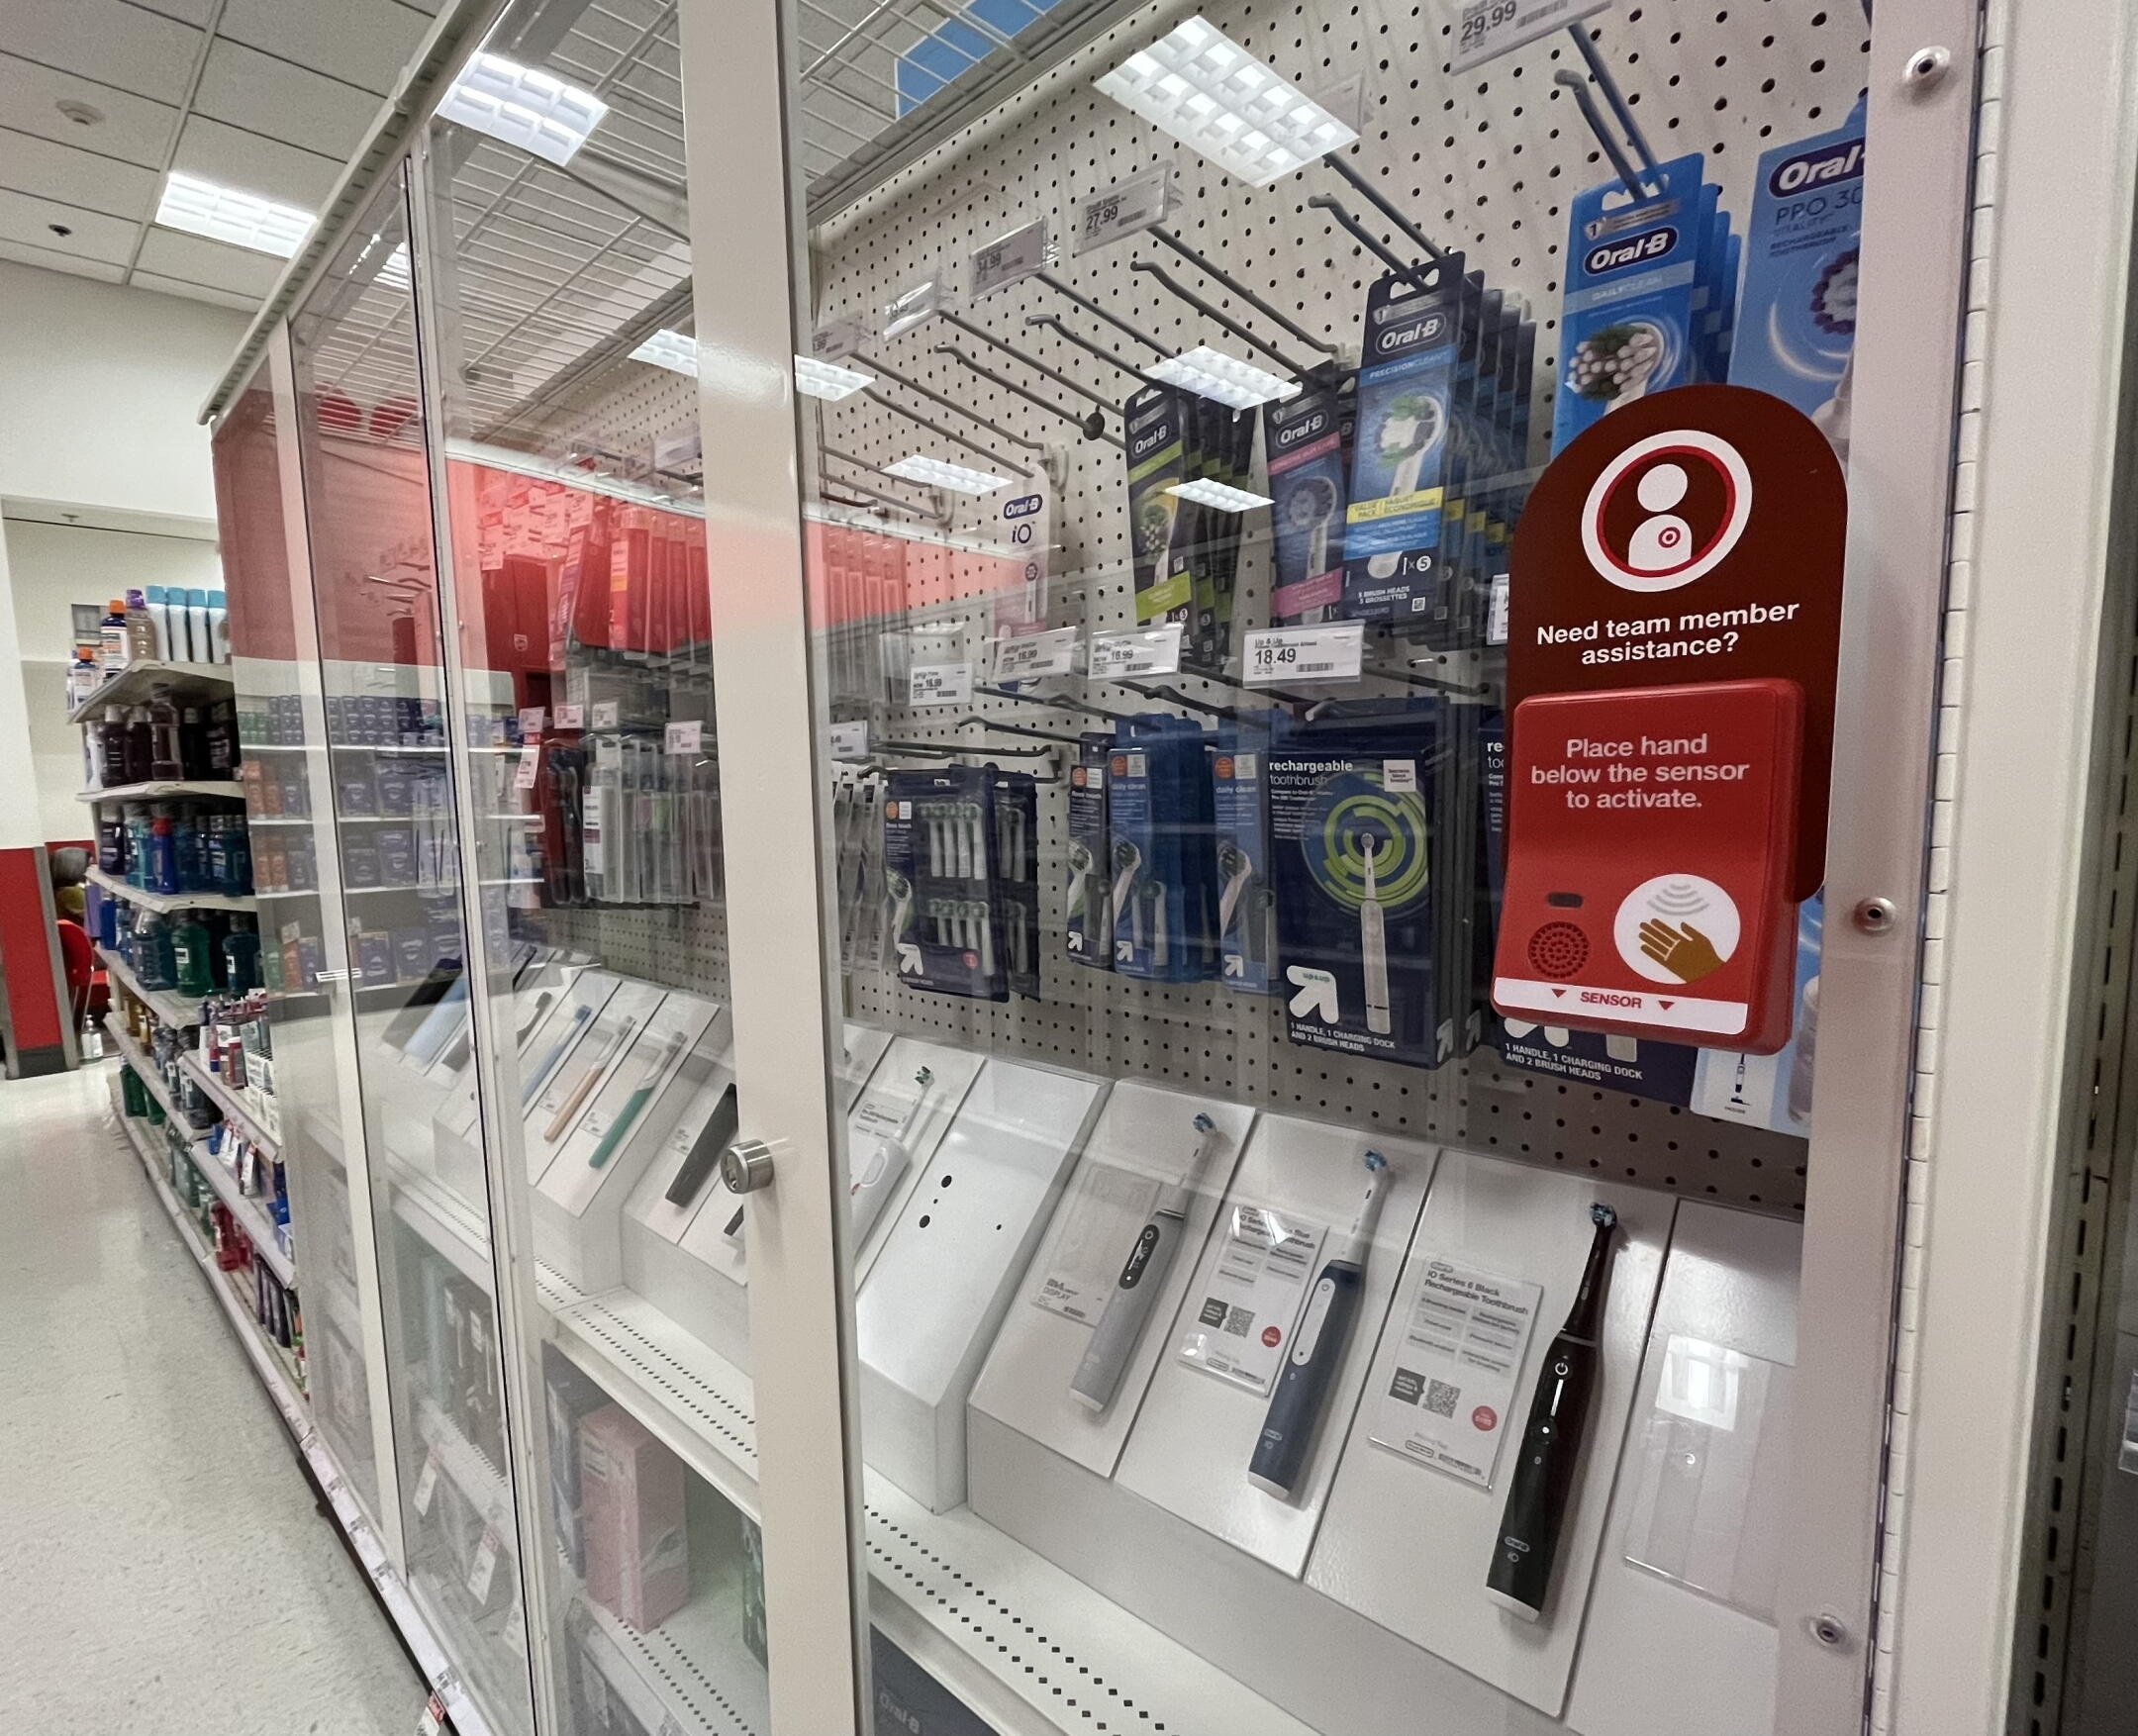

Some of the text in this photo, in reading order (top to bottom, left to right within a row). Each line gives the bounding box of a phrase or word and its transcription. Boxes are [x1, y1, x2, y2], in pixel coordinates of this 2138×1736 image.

[1461, 0, 1517, 43] 29.99
[1086, 205, 1118, 231] 27.99
[1591, 233, 1669, 270] Oral-B
[1382, 319, 1439, 348] Oral-B
[1134, 426, 1167, 453] Oral-B
[1280, 415, 1322, 443] Oral-B
[1005, 498, 1039, 516] Oral-B
[1537, 602, 1799, 645] Need team member
[1255, 648, 1297, 665] 18.49
[1582, 630, 1739, 665] assistance?
[1567, 732, 1708, 758] Place hand
[1269, 759, 1353, 774] rechargeable
[1530, 763, 1750, 784] below the sensor
[1270, 774, 1327, 786] toothbrush
[1566, 788, 1702, 809] to activate.
[1580, 992, 1642, 1009] SENSOR
[1373, 1037, 1396, 1049] DOCK
[1506, 1052, 1524, 1064] AND
[1535, 1059, 1567, 1073] BRUSH
[1569, 1067, 1602, 1081] HEADS
[1512, 1044, 1552, 1060] HANDLE,
[1561, 1055, 1611, 1073] CHARGING
[1614, 1066, 1643, 1080] DOCK
[1424, 1279, 1529, 1315] Rechargeable Toothbrush
[1438, 1273, 1466, 1288] Series
[1475, 1283, 1500, 1297] Black
